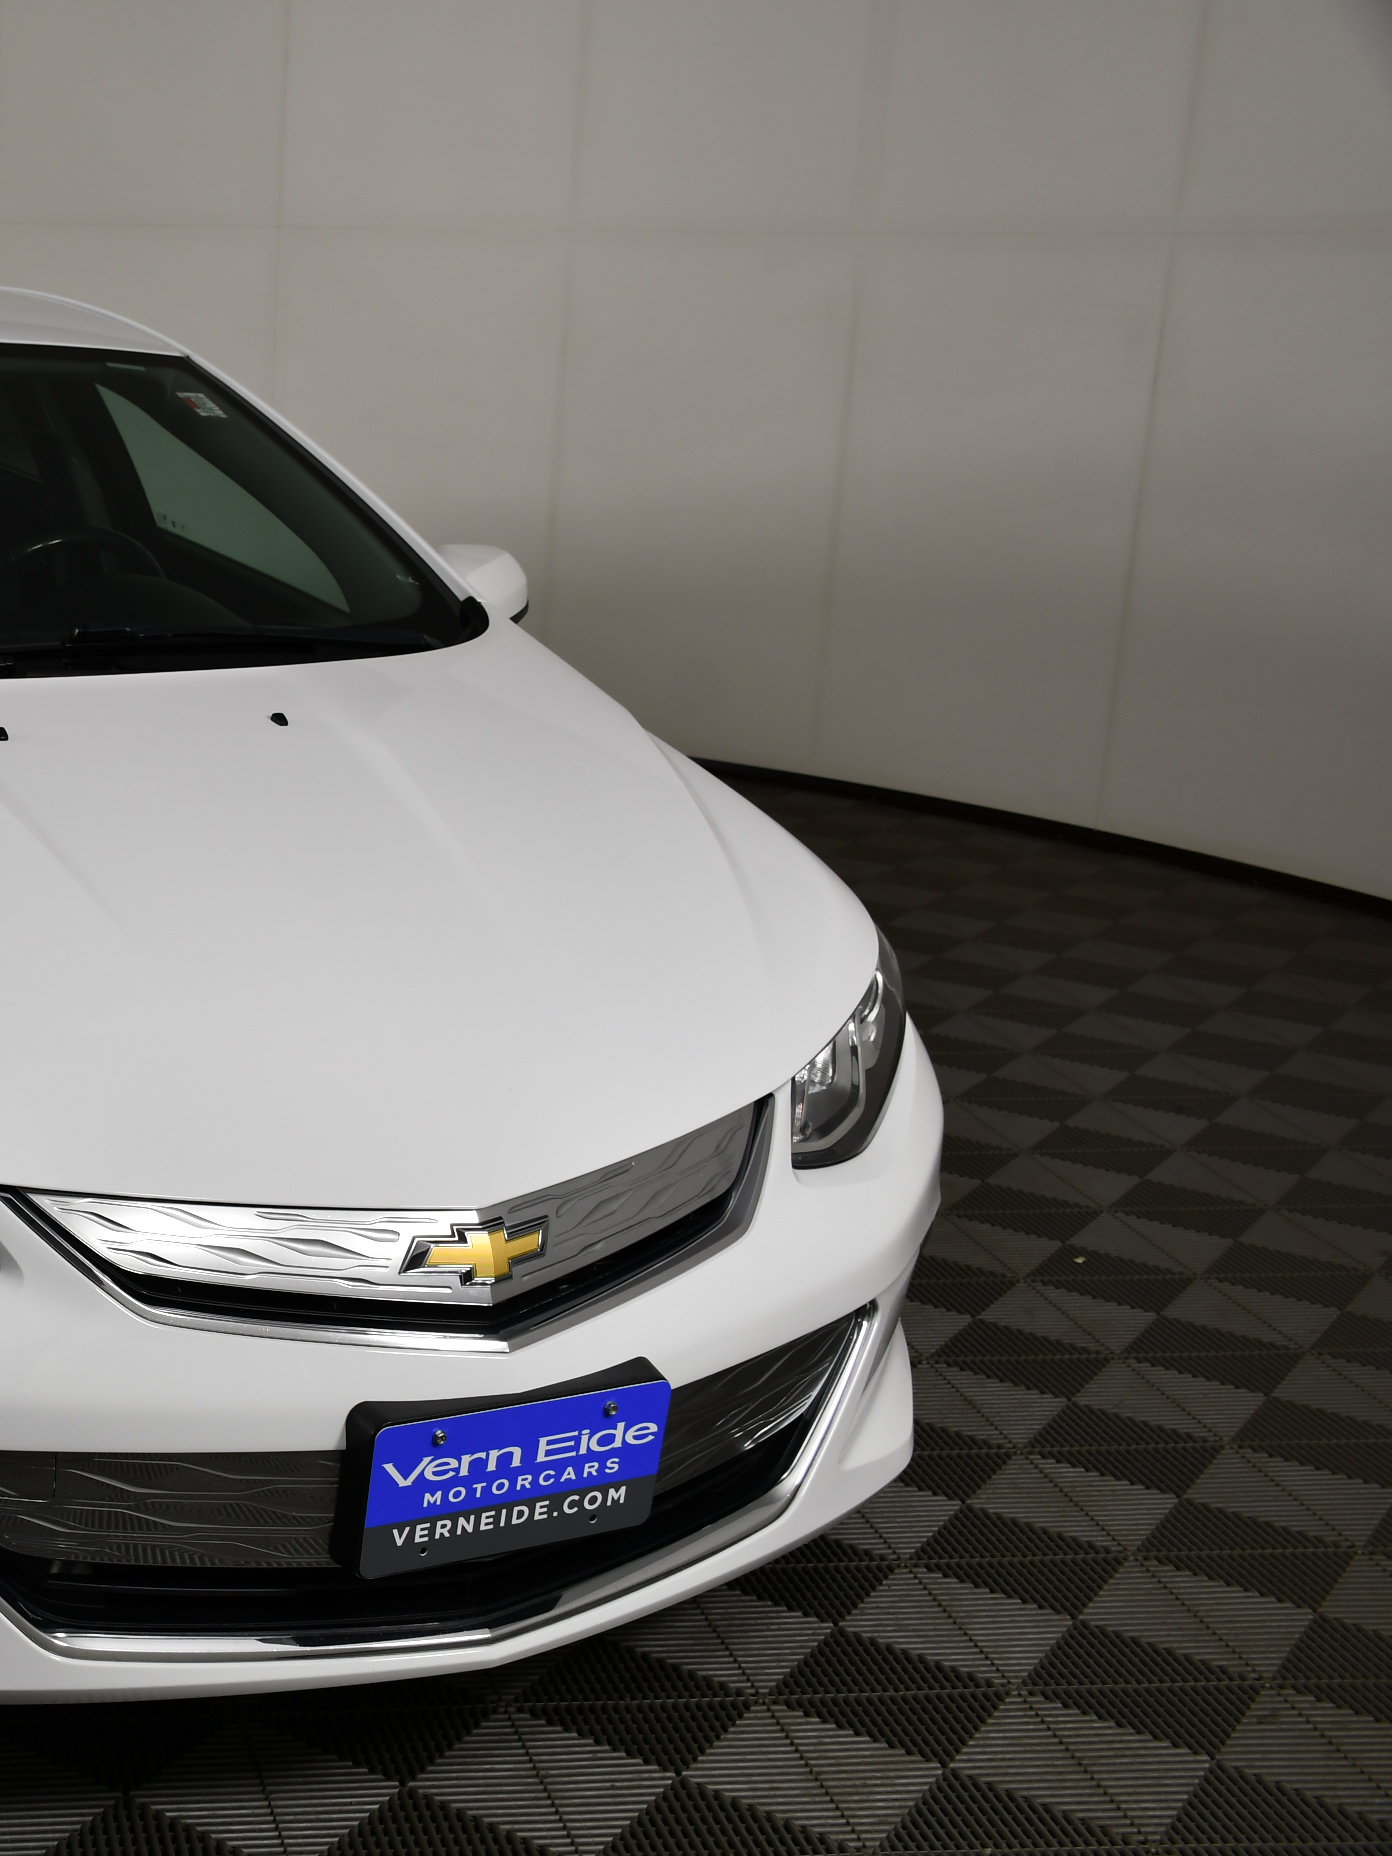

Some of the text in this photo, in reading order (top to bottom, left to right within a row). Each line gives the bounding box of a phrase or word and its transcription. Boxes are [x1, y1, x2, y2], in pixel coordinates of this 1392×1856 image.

[382, 1421, 658, 1488] Vern Eide
[423, 1457, 620, 1508] MOTORCARS
[392, 1486, 627, 1547] VERNEIDE.COM
